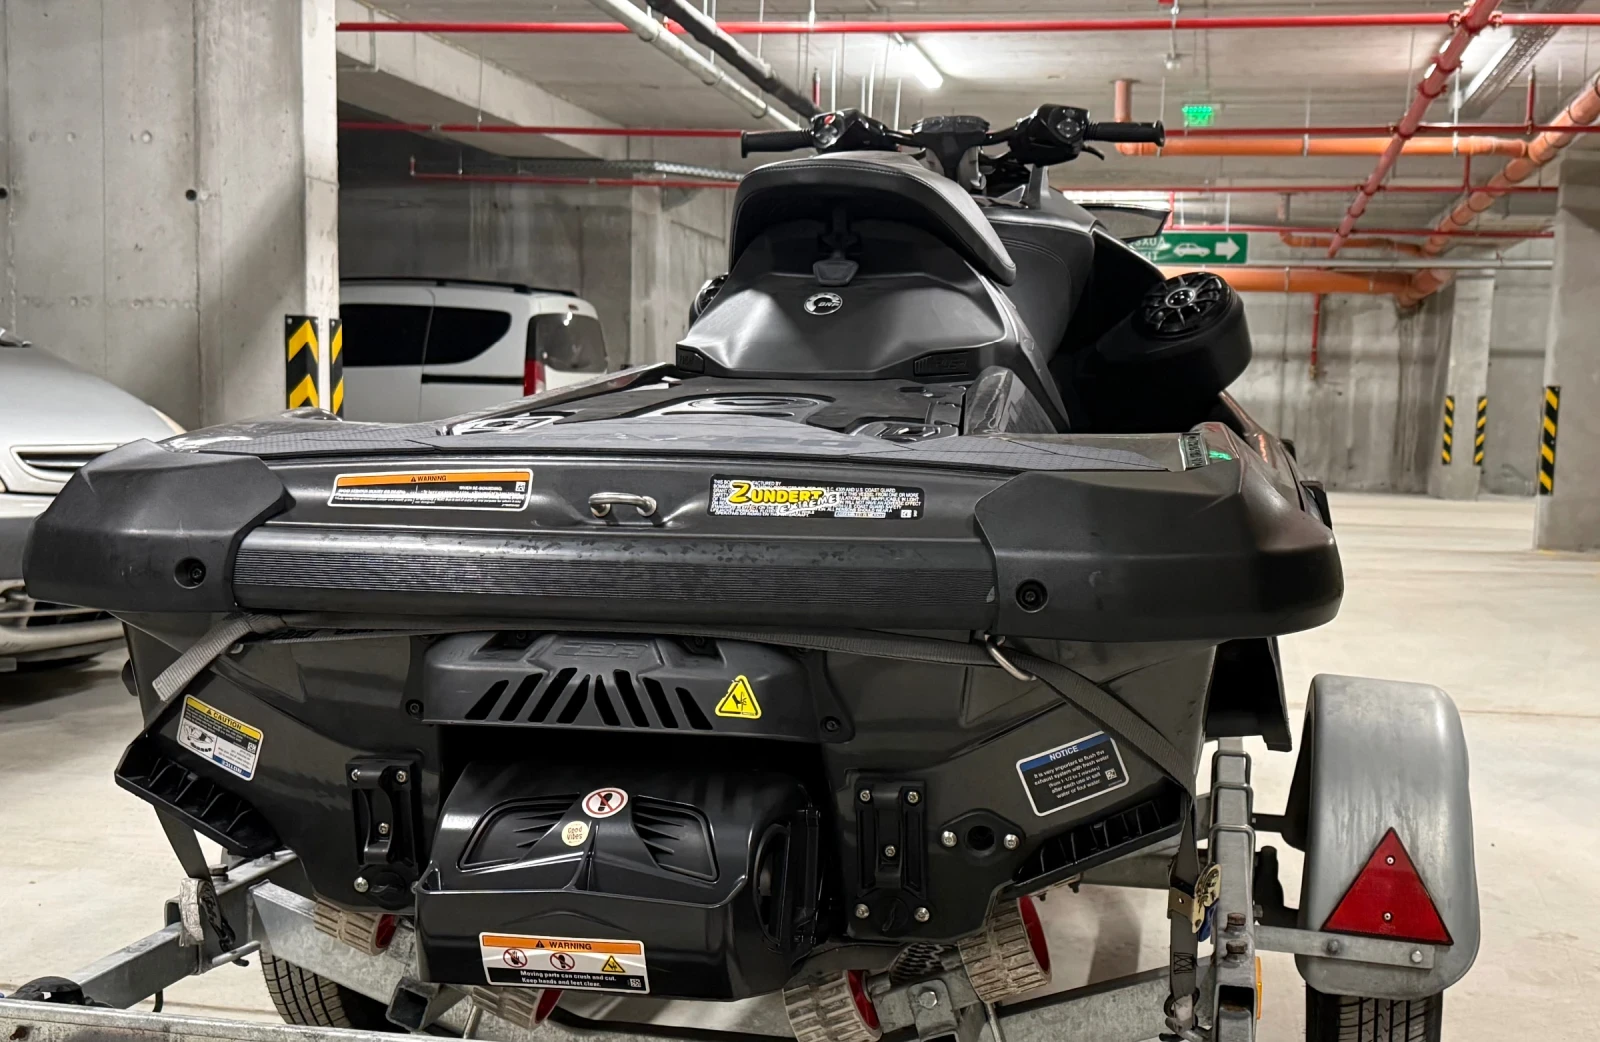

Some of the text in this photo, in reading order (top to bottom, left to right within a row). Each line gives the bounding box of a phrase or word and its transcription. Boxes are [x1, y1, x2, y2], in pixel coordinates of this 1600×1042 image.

[729, 482, 824, 504] ZUNDERT
[213, 712, 242, 730] CAUTION
[1049, 745, 1079, 761] NOTICE
[1034, 755, 1109, 785] exhaust system with fresh water
[1043, 768, 1055, 776] very
[1055, 761, 1078, 772] important
[1084, 753, 1096, 761] flush
[1051, 786, 1063, 794] after
[1064, 781, 1076, 790] each
[1056, 791, 1070, 799] water
[549, 941, 592, 951] WARNING
[520, 970, 543, 978] Moving
